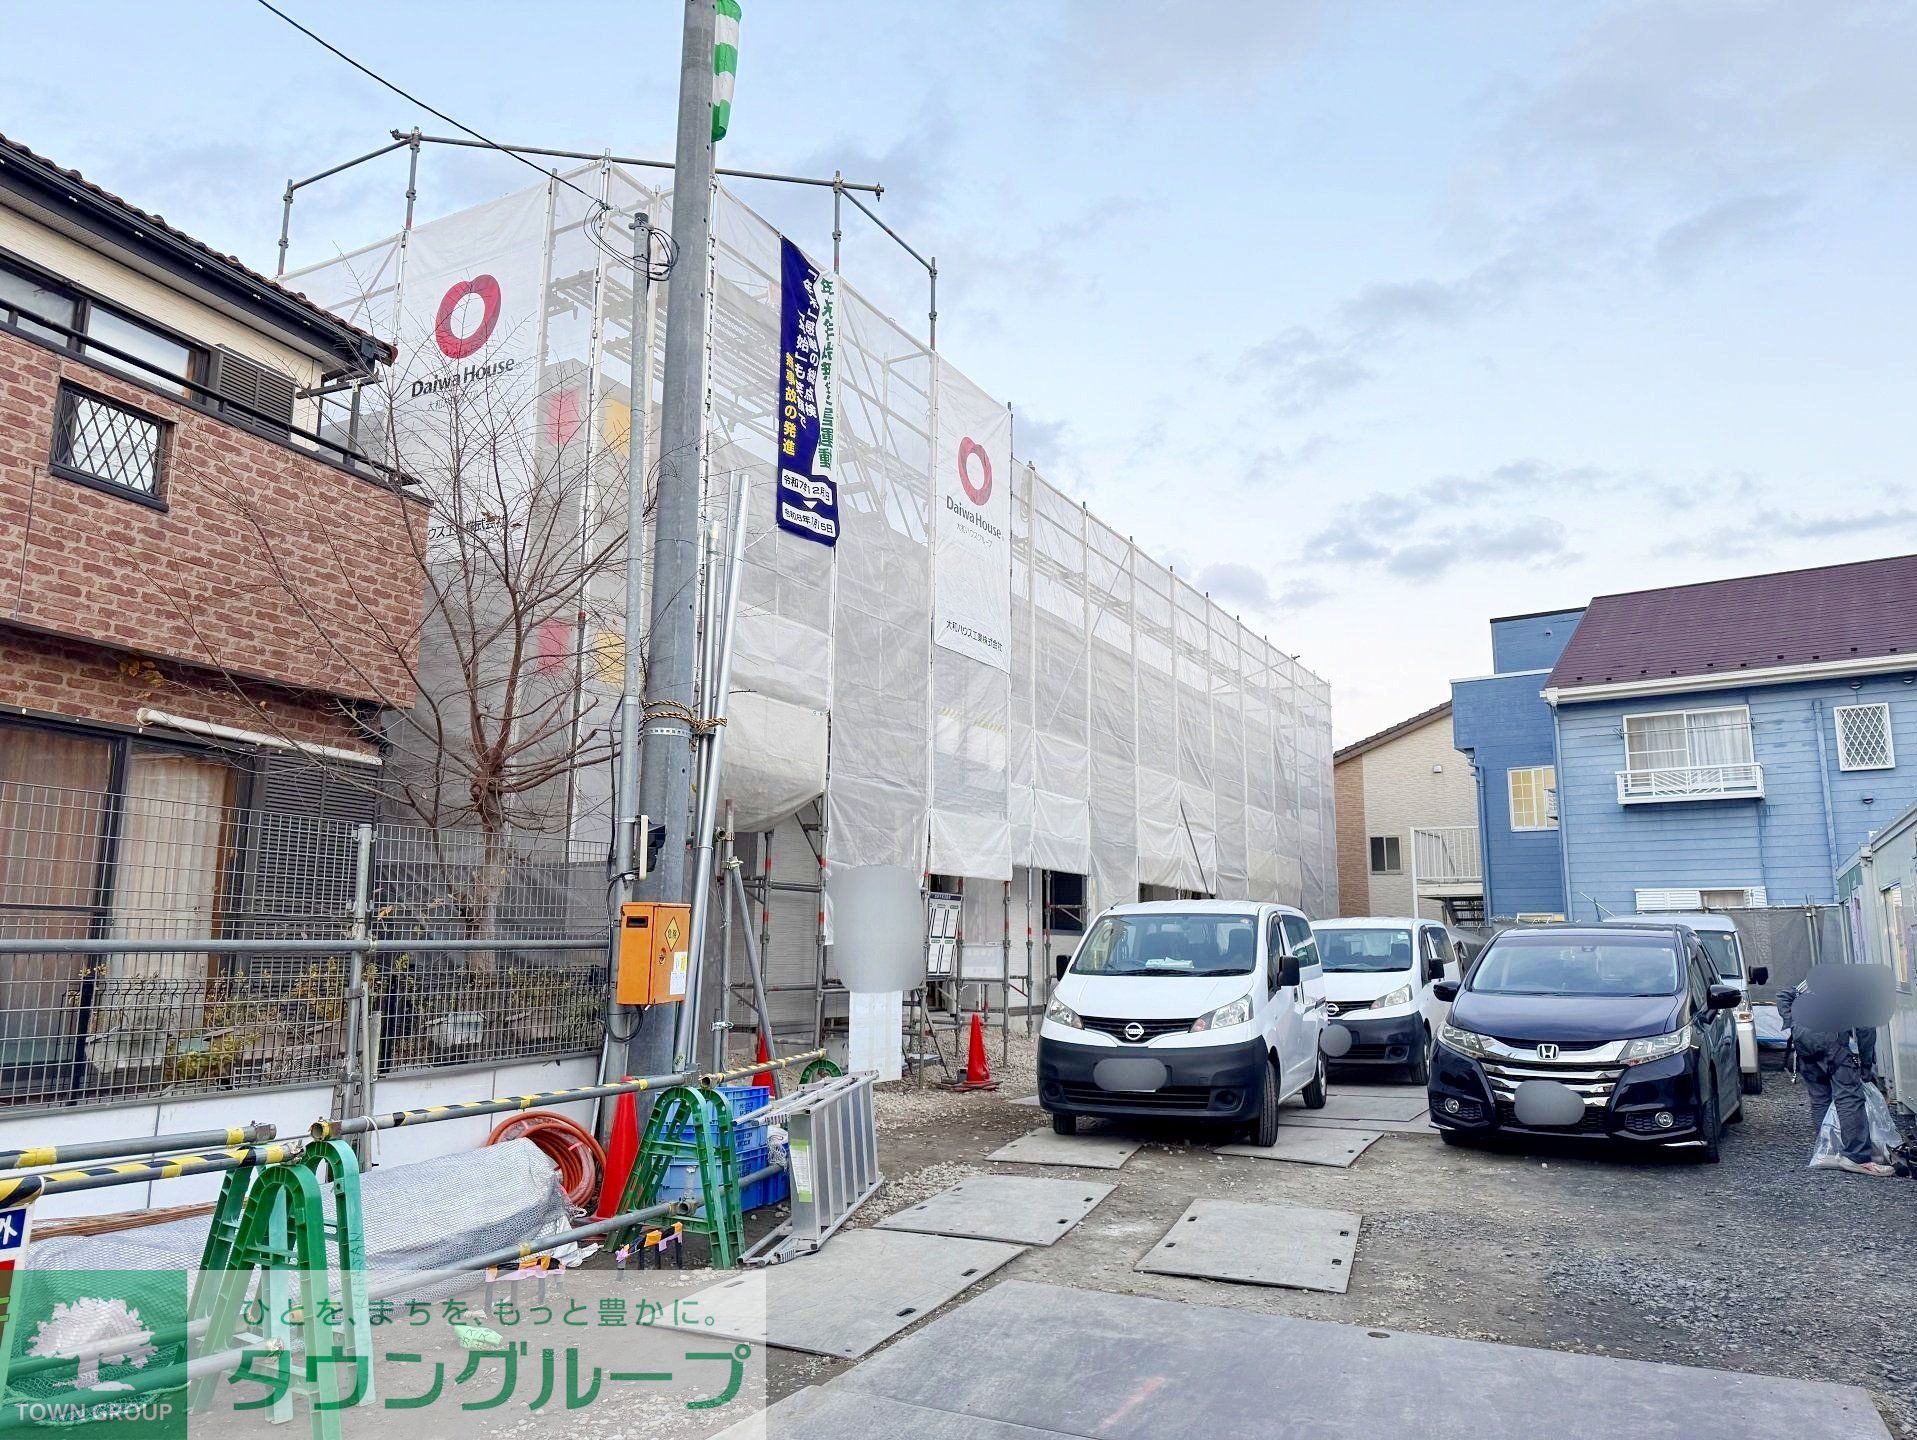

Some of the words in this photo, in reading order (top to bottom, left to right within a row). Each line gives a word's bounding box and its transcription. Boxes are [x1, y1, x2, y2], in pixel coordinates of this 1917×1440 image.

[411, 373, 461, 398] Daiwa
[463, 358, 515, 384] House
[782, 351, 797, 457] 無事故の発進
[946, 495, 975, 524] Daiwa
[975, 512, 1002, 540] House
[946, 620, 1003, 653] 大和ハウス工業株式会社
